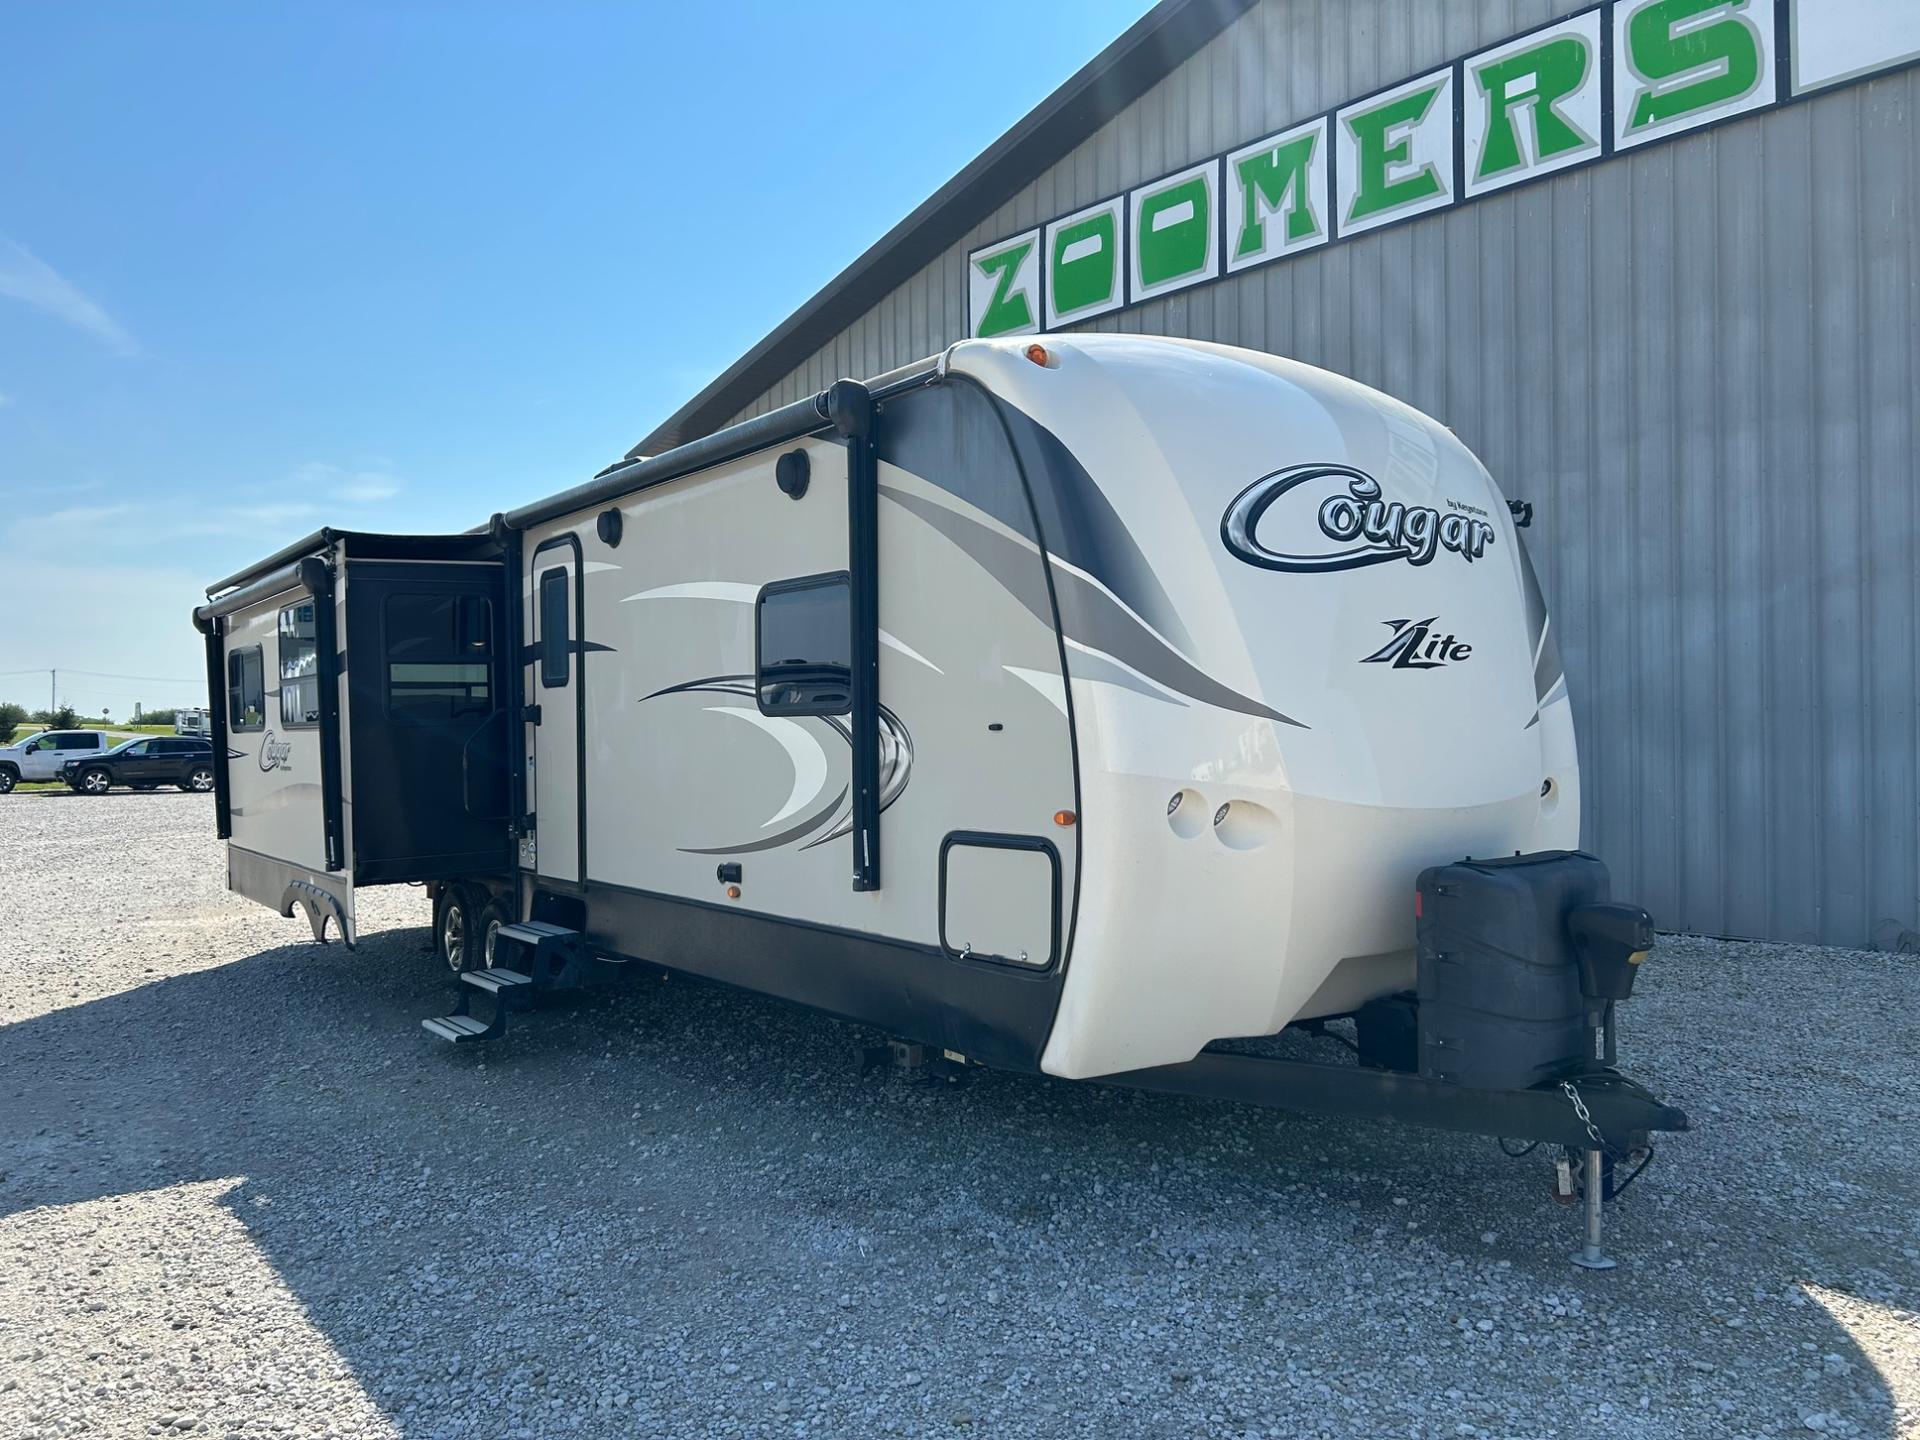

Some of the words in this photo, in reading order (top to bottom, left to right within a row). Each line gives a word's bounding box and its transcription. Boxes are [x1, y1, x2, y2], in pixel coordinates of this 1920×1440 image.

[976, 0, 1768, 338] ZOOMERS
[1220, 462, 1495, 574] Cougar
[259, 729, 291, 773] Cougar
